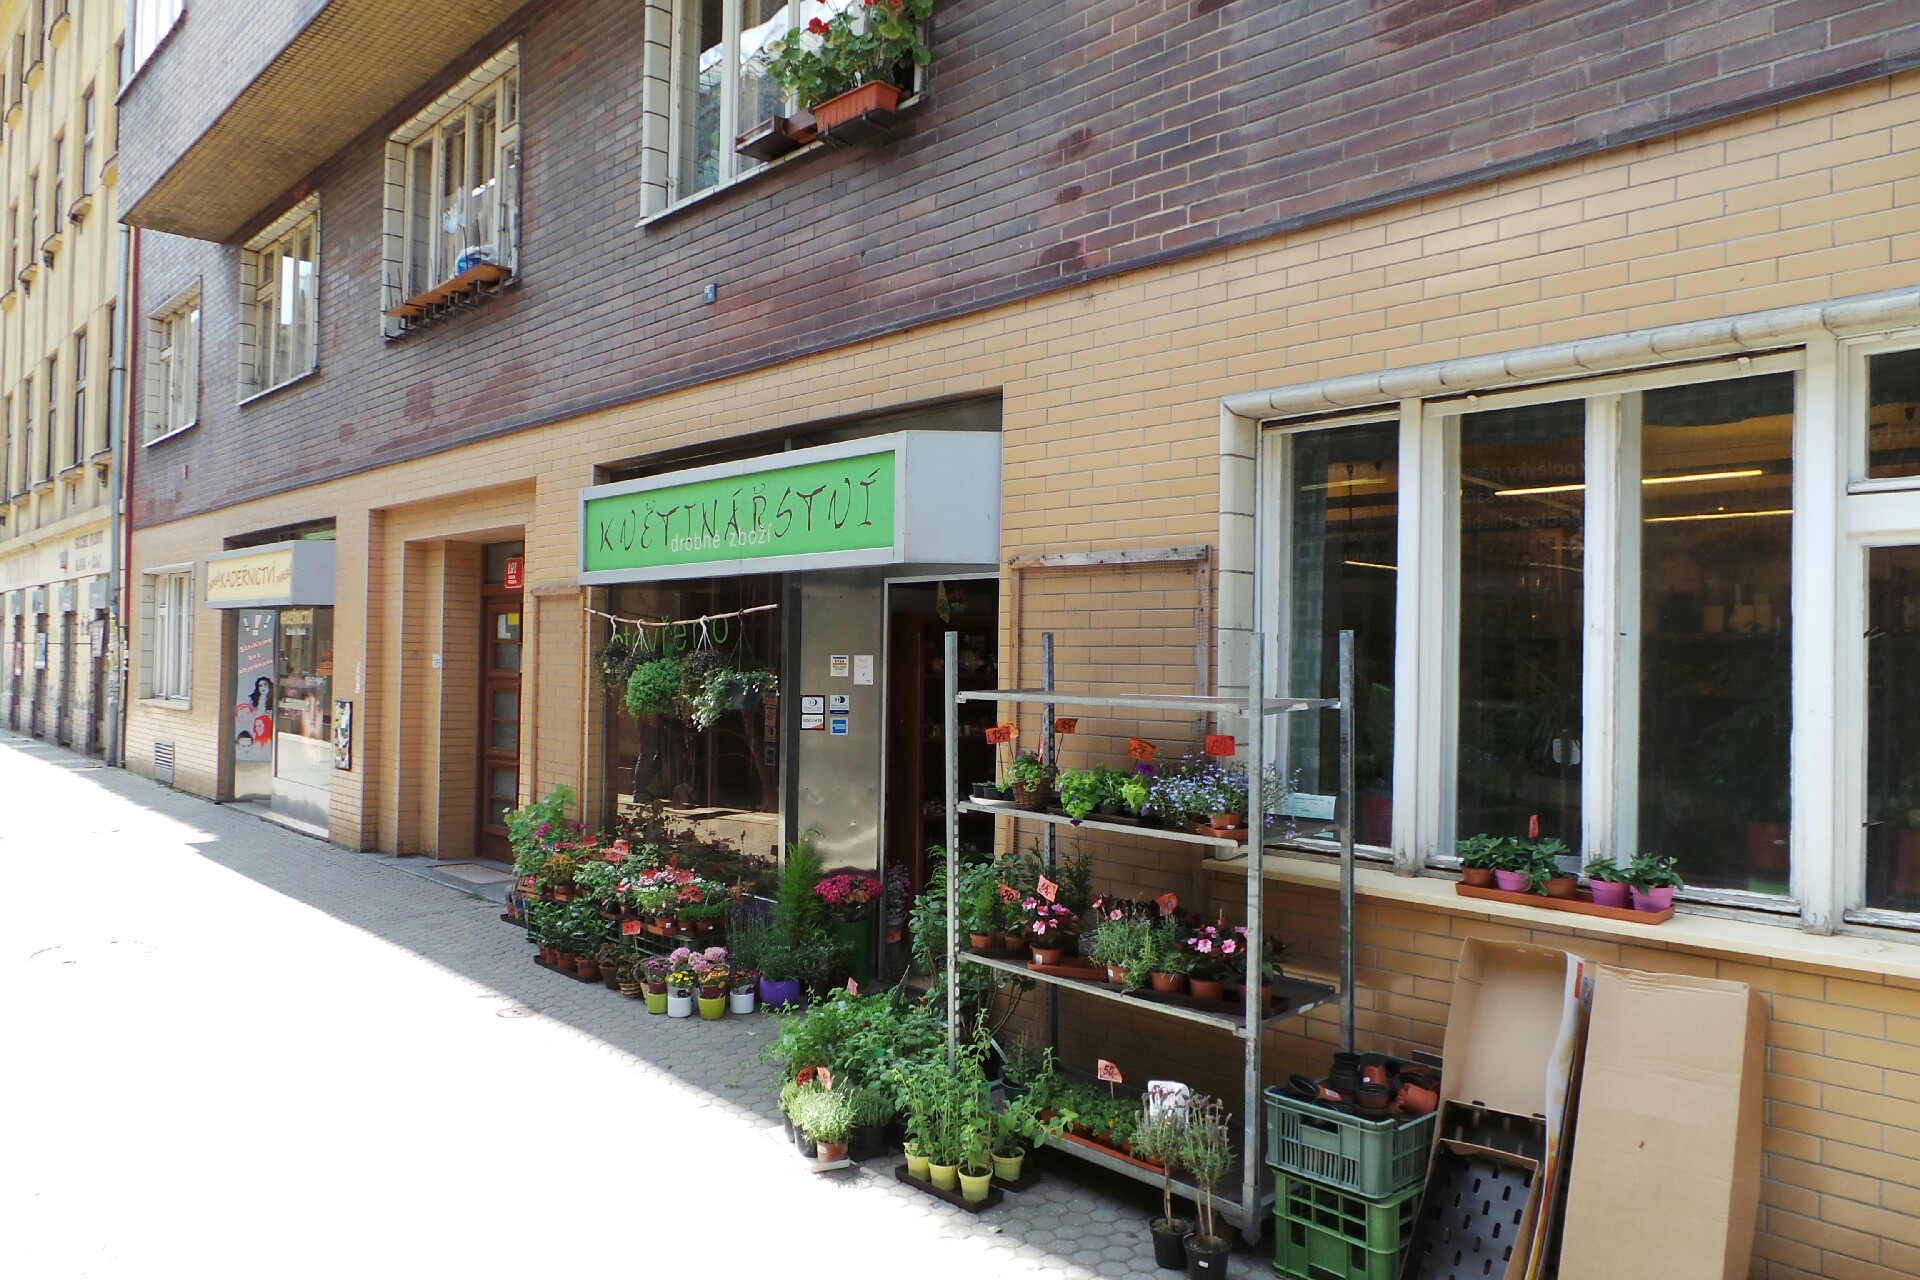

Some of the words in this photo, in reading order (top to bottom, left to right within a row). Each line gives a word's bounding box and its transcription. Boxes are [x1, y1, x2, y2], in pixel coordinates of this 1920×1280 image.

[599, 468, 881, 552] KVĚTINÁŘSTVÍ
[671, 528, 720, 552] drobné
[729, 523, 771, 548] zboží
[220, 560, 276, 588] KADEŘNICTVÍ
